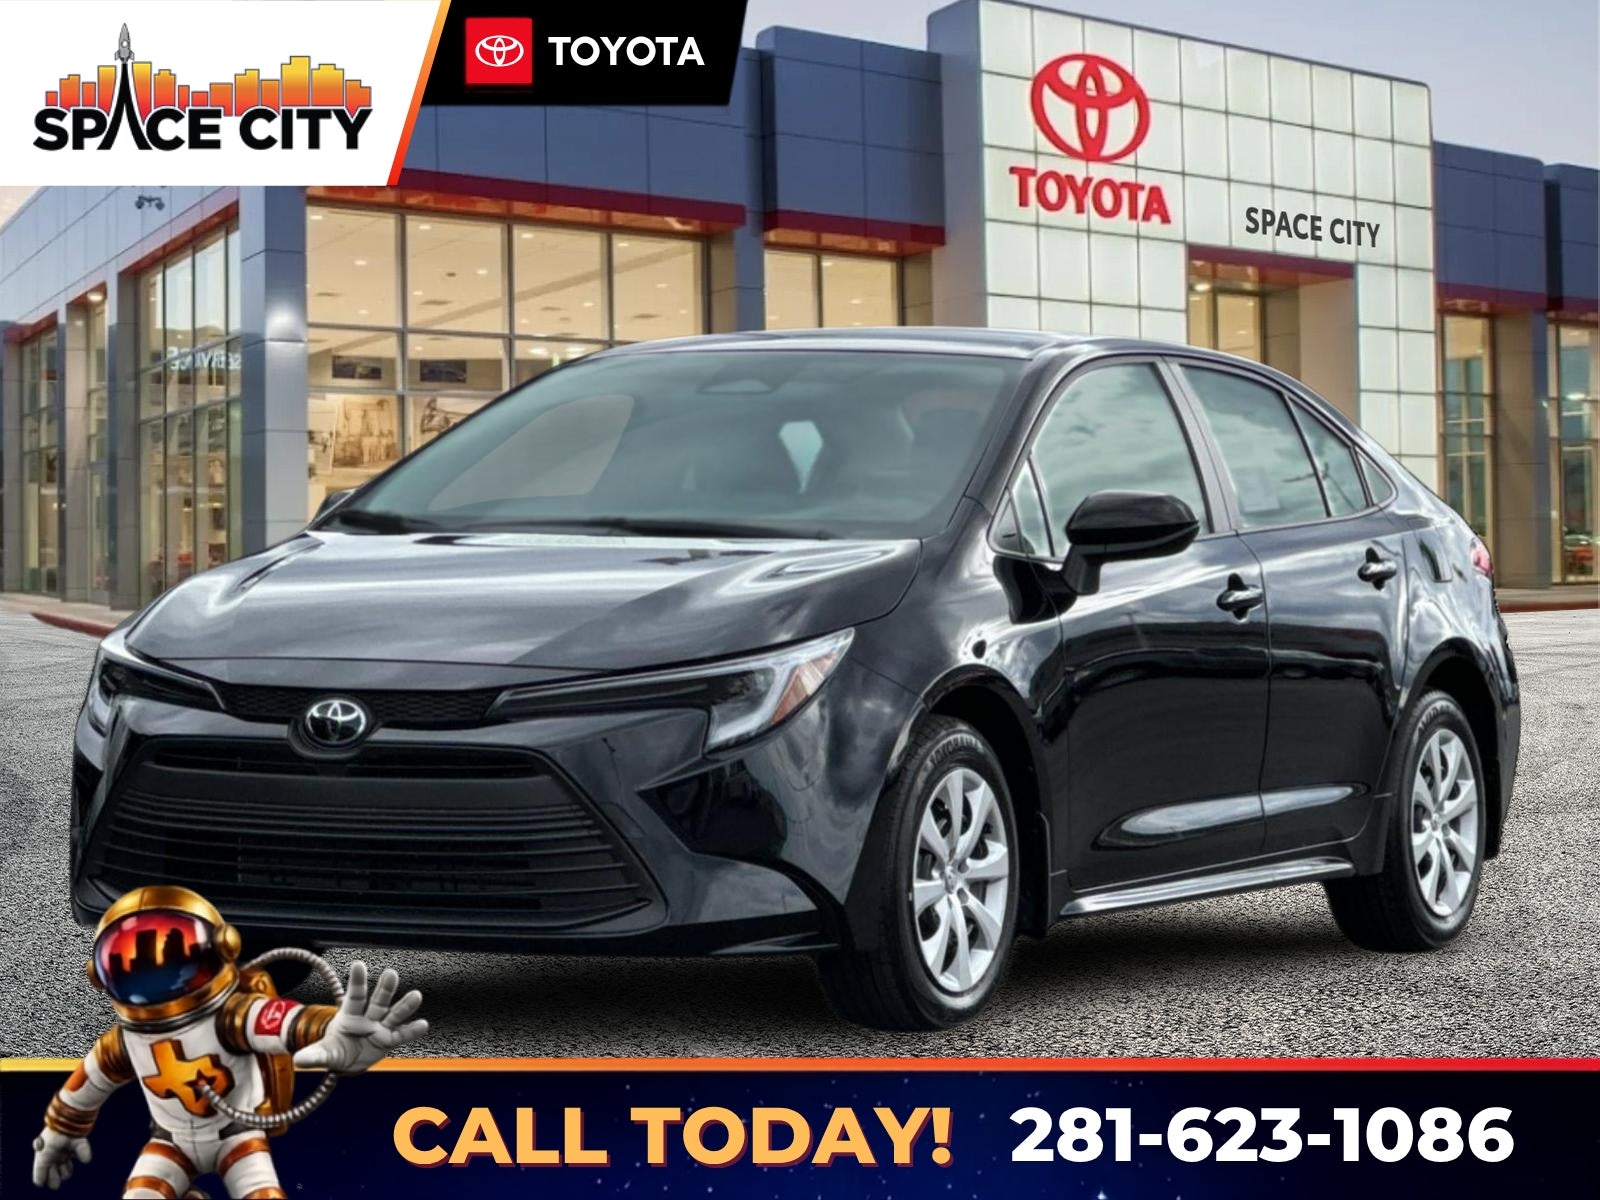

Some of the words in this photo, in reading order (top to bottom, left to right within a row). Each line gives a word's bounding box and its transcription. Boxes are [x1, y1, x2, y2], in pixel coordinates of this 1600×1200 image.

[1009, 166, 1171, 225] TOYOTA
[1245, 207, 1323, 242] SPACE
[1329, 218, 1381, 249] CITY
